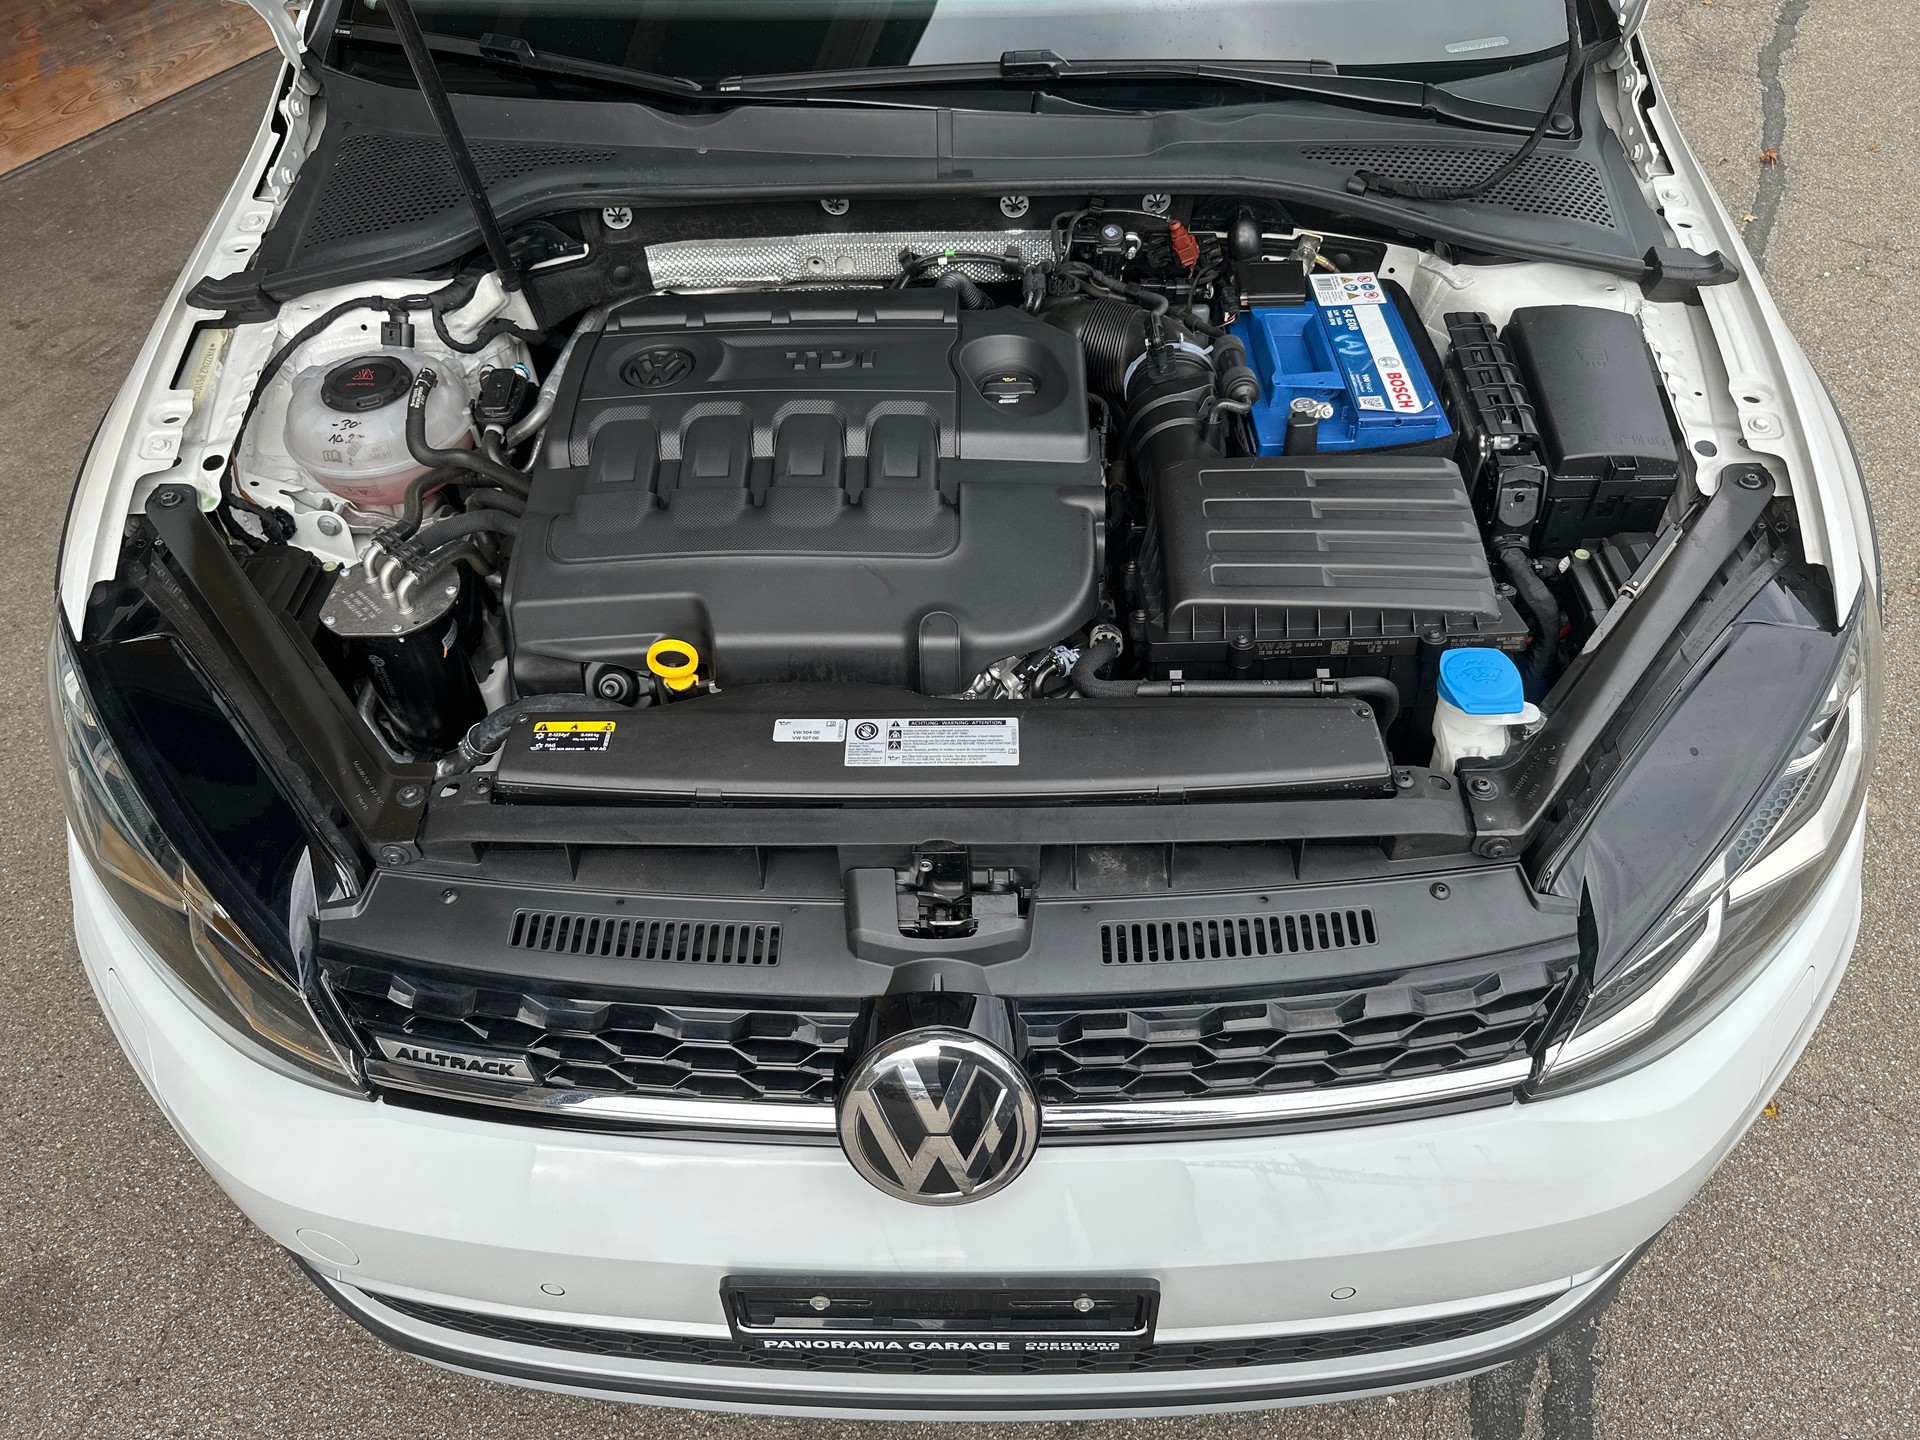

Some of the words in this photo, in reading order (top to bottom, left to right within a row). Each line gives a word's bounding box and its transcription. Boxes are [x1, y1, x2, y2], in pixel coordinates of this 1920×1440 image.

[1342, 309, 1354, 318] S4
[785, 350, 877, 370] TDI
[1386, 372, 1415, 408] BOSCH
[395, 1047, 515, 1077] ALLTRACK
[763, 1340, 904, 1350] PANORAMA
[908, 1341, 1011, 1350] GARAGE
